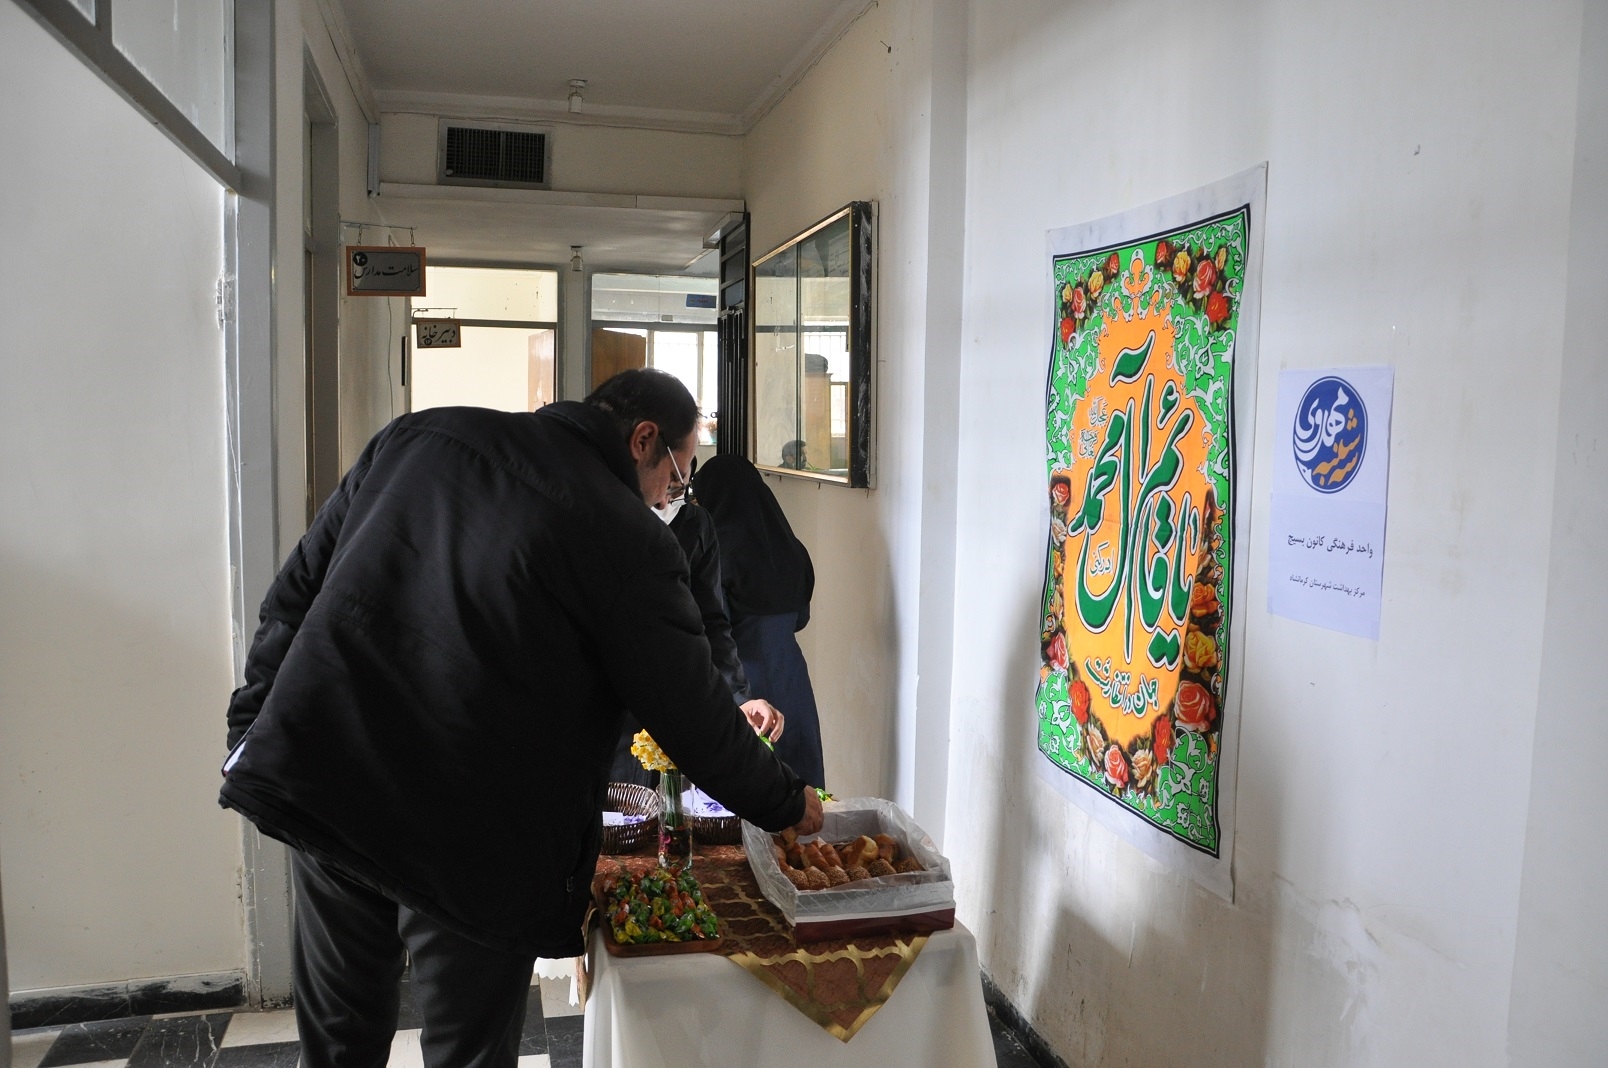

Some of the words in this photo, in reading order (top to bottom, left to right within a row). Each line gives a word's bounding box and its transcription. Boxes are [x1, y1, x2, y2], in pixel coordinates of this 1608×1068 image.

[354, 266, 382, 279] مدارس
[382, 264, 420, 276] سلامت
[1287, 534, 1305, 546] بسیج
[1306, 535, 1325, 549] کانون
[1326, 537, 1354, 554] فرهنگی
[1356, 542, 1373, 558] واحد
[1309, 578, 1332, 591] شهرستان
[1332, 583, 1353, 596] بهداشت
[1354, 587, 1366, 598] مرکز
